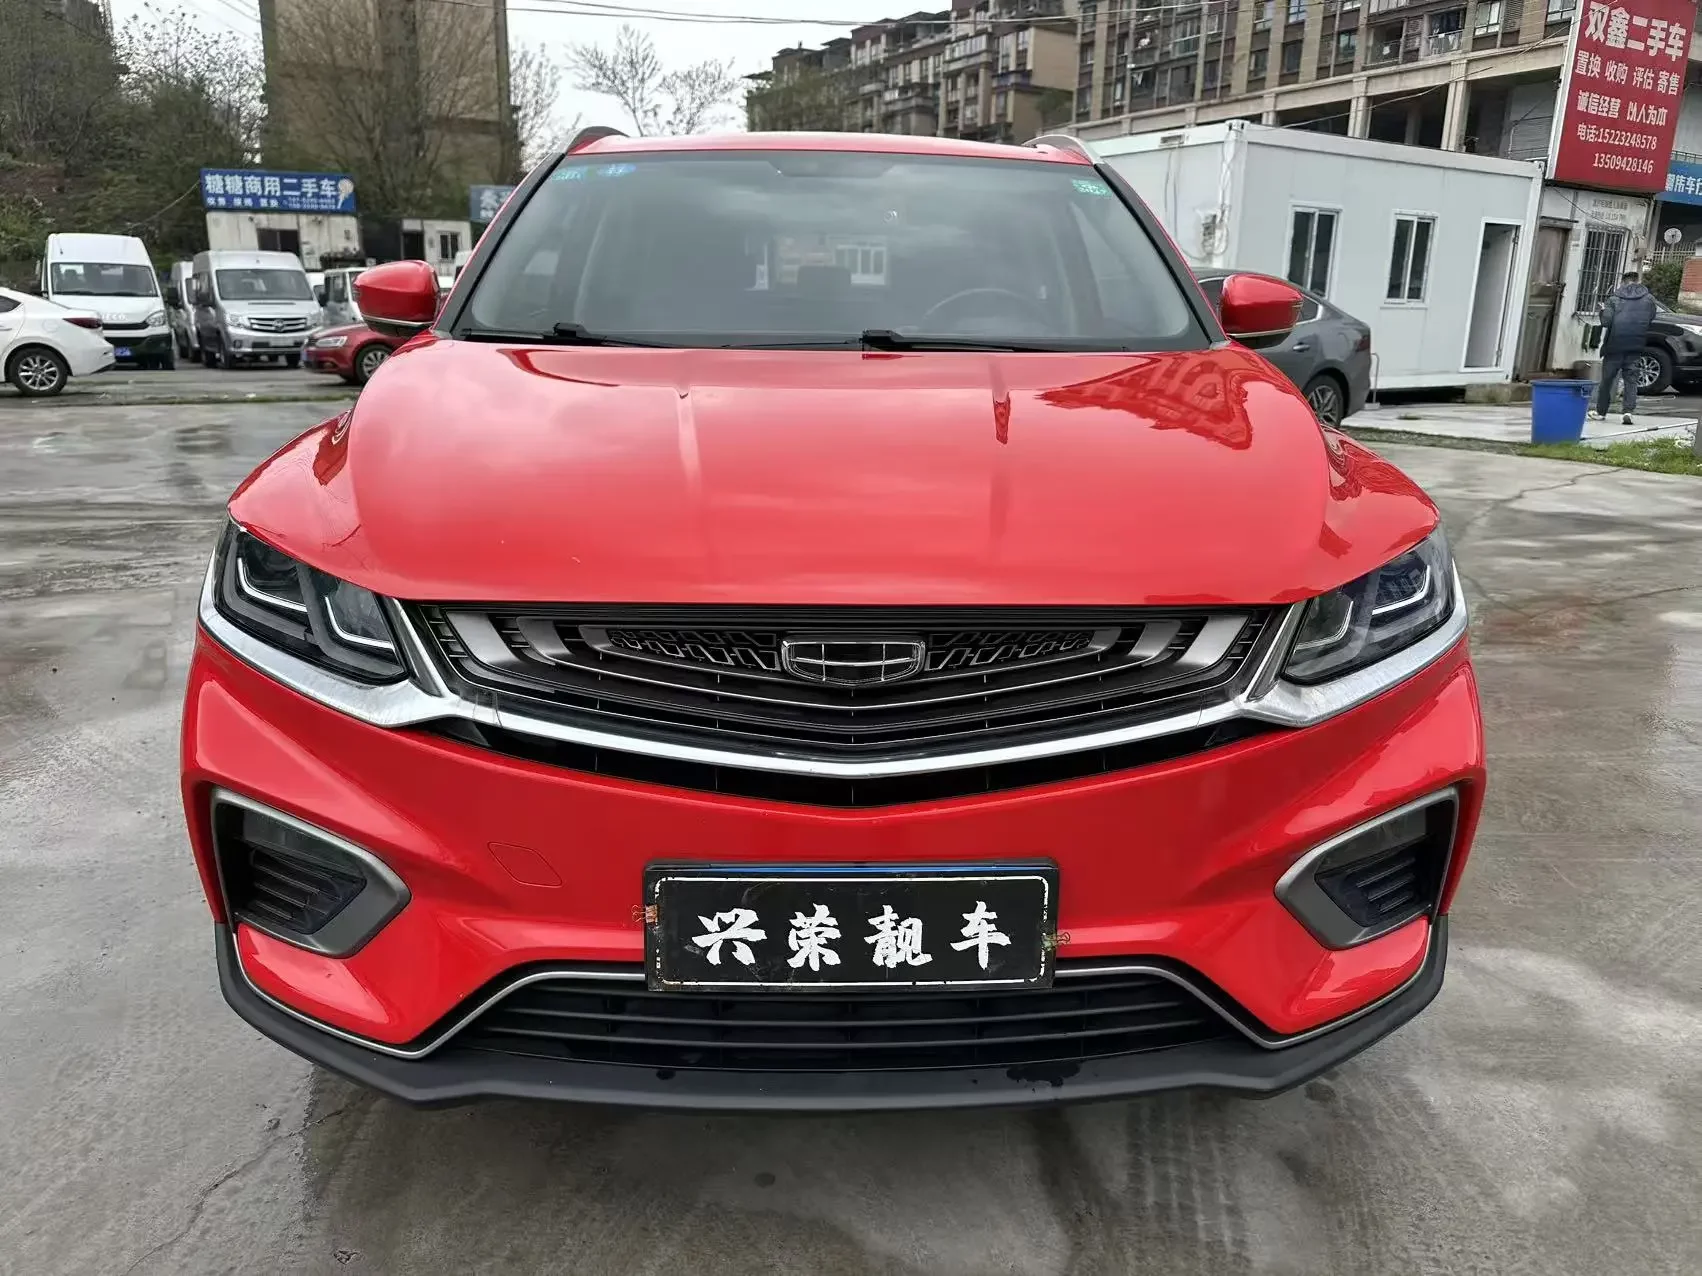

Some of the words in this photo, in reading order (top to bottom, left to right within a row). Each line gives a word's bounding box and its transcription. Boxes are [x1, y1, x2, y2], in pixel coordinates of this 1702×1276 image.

[1584, 1, 1687, 62] 双鑫二手车
[1575, 50, 1602, 78] 置换
[1604, 60, 1628, 84] 收购
[1632, 66, 1655, 90] 评估
[1657, 70, 1681, 96] 寄售
[1577, 90, 1621, 119] 诚信经营
[1626, 101, 1668, 126] 以人为本
[1593, 153, 1654, 174] 13509428146
[204, 173, 337, 197] 糖糖商用二手车
[692, 901, 1011, 971] 兴荣靓车
